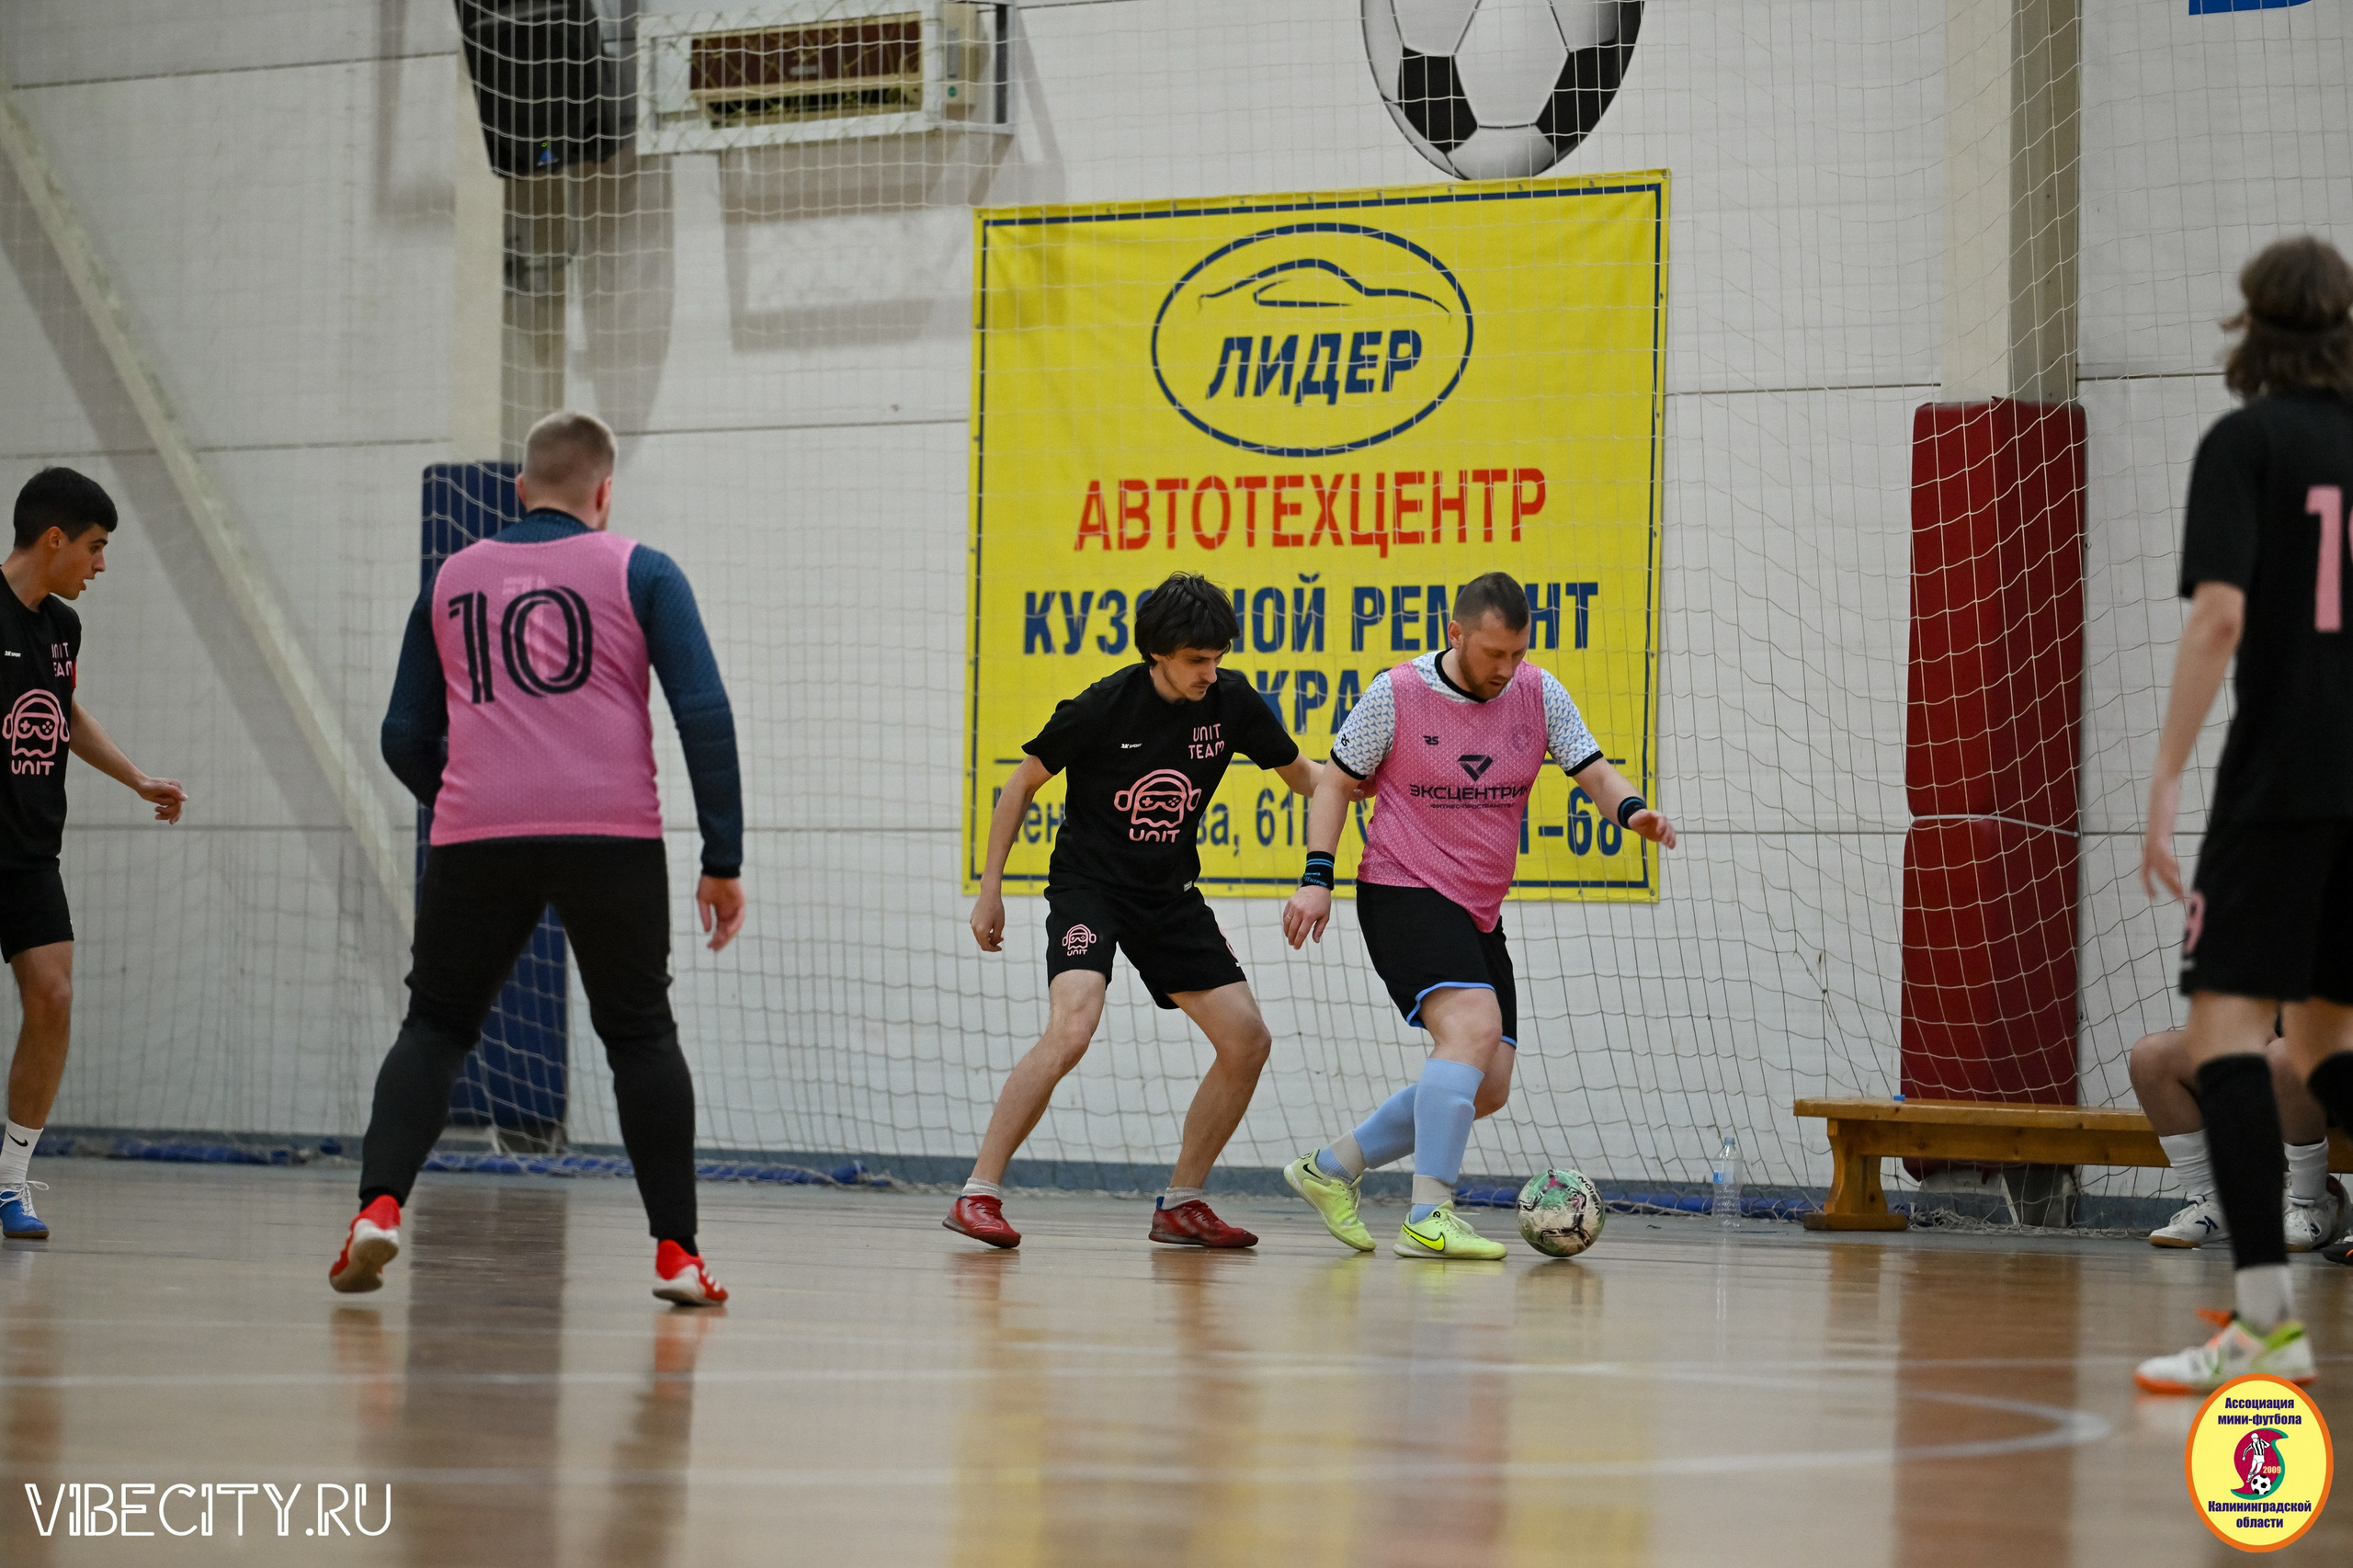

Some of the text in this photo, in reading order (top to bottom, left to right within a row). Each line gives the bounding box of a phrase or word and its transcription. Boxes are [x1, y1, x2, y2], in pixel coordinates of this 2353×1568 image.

[1207, 329, 1422, 405] ЛИДЕР
[1074, 468, 1547, 558] АВТОТЕХЦЕНТР
[2305, 486, 2353, 632] 1
[1351, 582, 1598, 652] РЕМНТ
[449, 585, 593, 704] 10
[1188, 740, 1224, 759] TEAM
[1193, 723, 1221, 742] UNIT
[12, 759, 54, 776] UNIT
[1410, 783, 1530, 801] ЭКСЦЕНТРИК
[1129, 827, 1180, 843] UNIT
